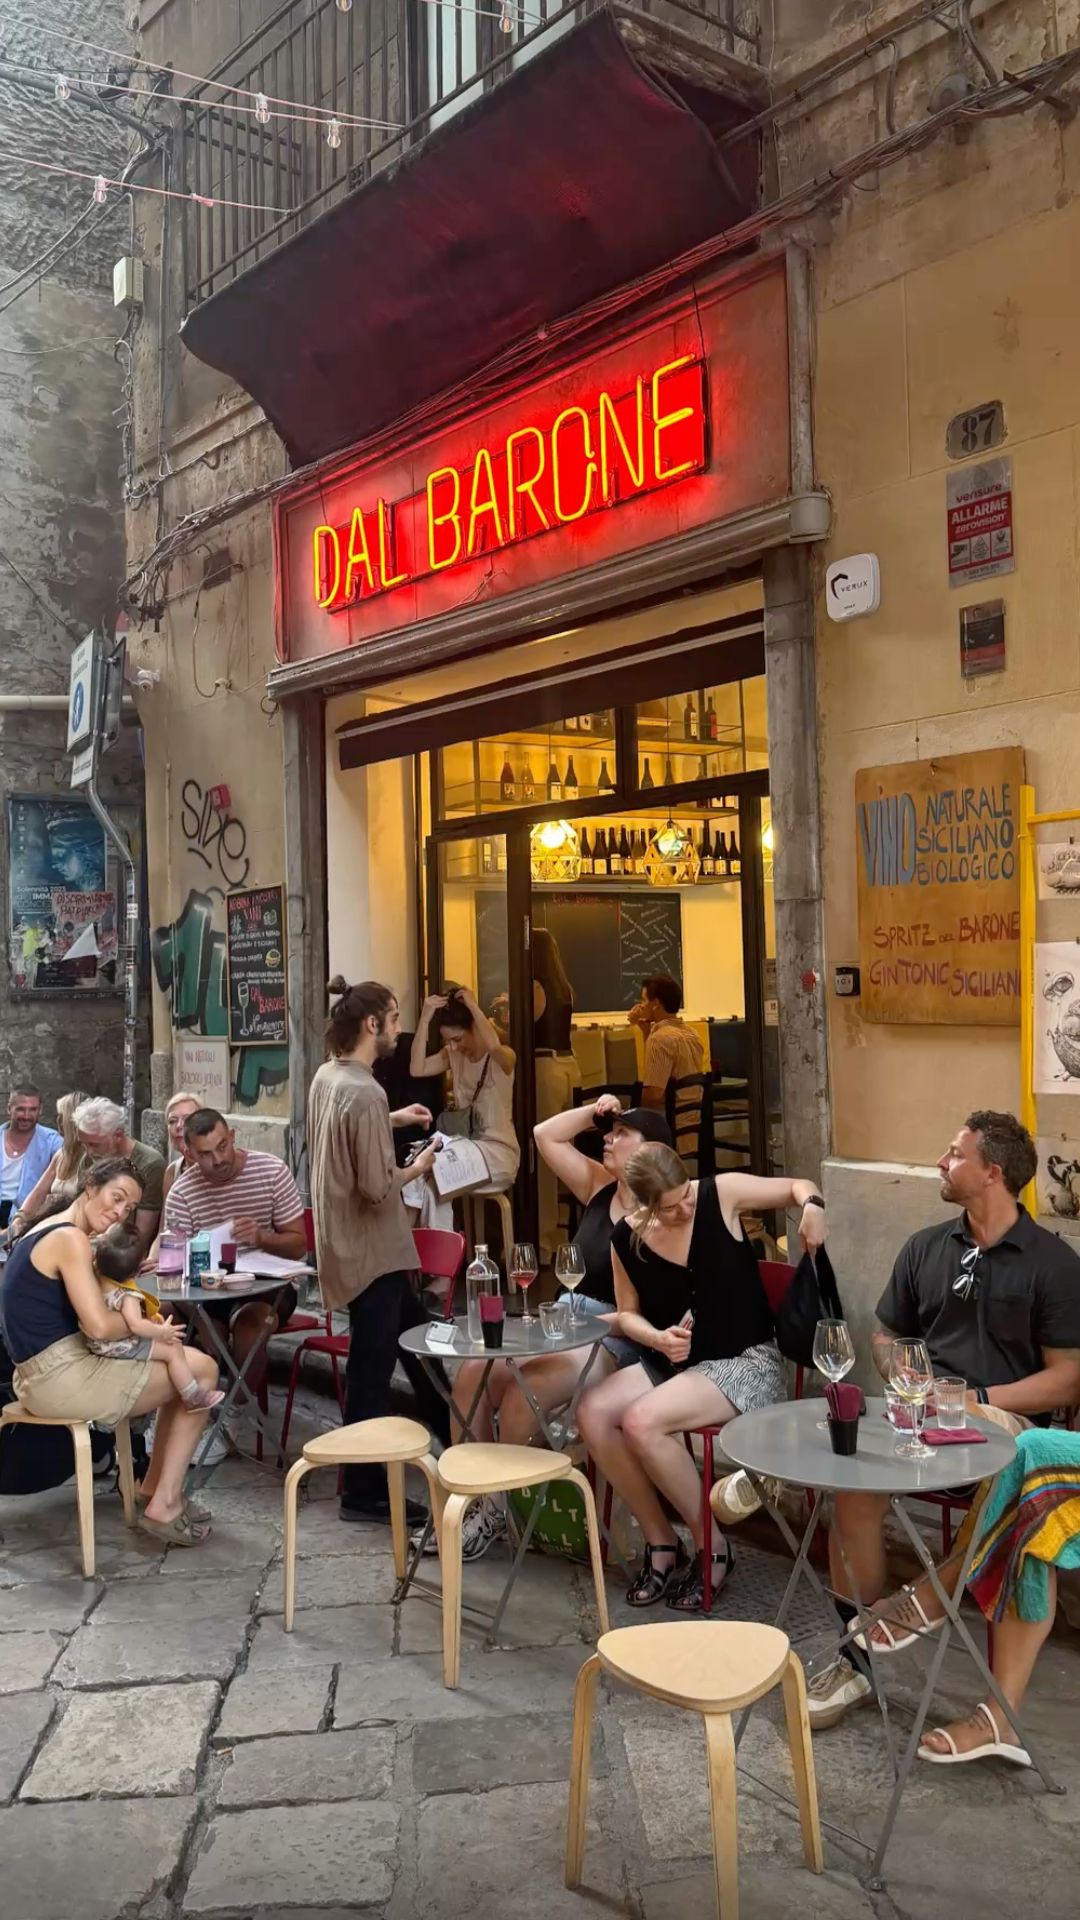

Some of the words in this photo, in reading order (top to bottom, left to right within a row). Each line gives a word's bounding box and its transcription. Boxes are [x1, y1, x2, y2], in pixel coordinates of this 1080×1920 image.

[961, 408, 996, 452] 87
[312, 497, 409, 609] DAL
[425, 352, 697, 571] BARONE
[955, 483, 1003, 503] verisure
[951, 496, 1009, 525] ALLARME
[840, 579, 869, 593] VERUX
[926, 783, 1013, 827] NATURALE
[857, 785, 917, 888] VINO
[916, 818, 1015, 854] SICILIANO
[917, 850, 1015, 886] BIOLOGICO
[873, 923, 937, 950] SPRITZ
[957, 911, 1020, 944] BARONE
[869, 959, 899, 988] GIN
[896, 957, 950, 986] TONIC
